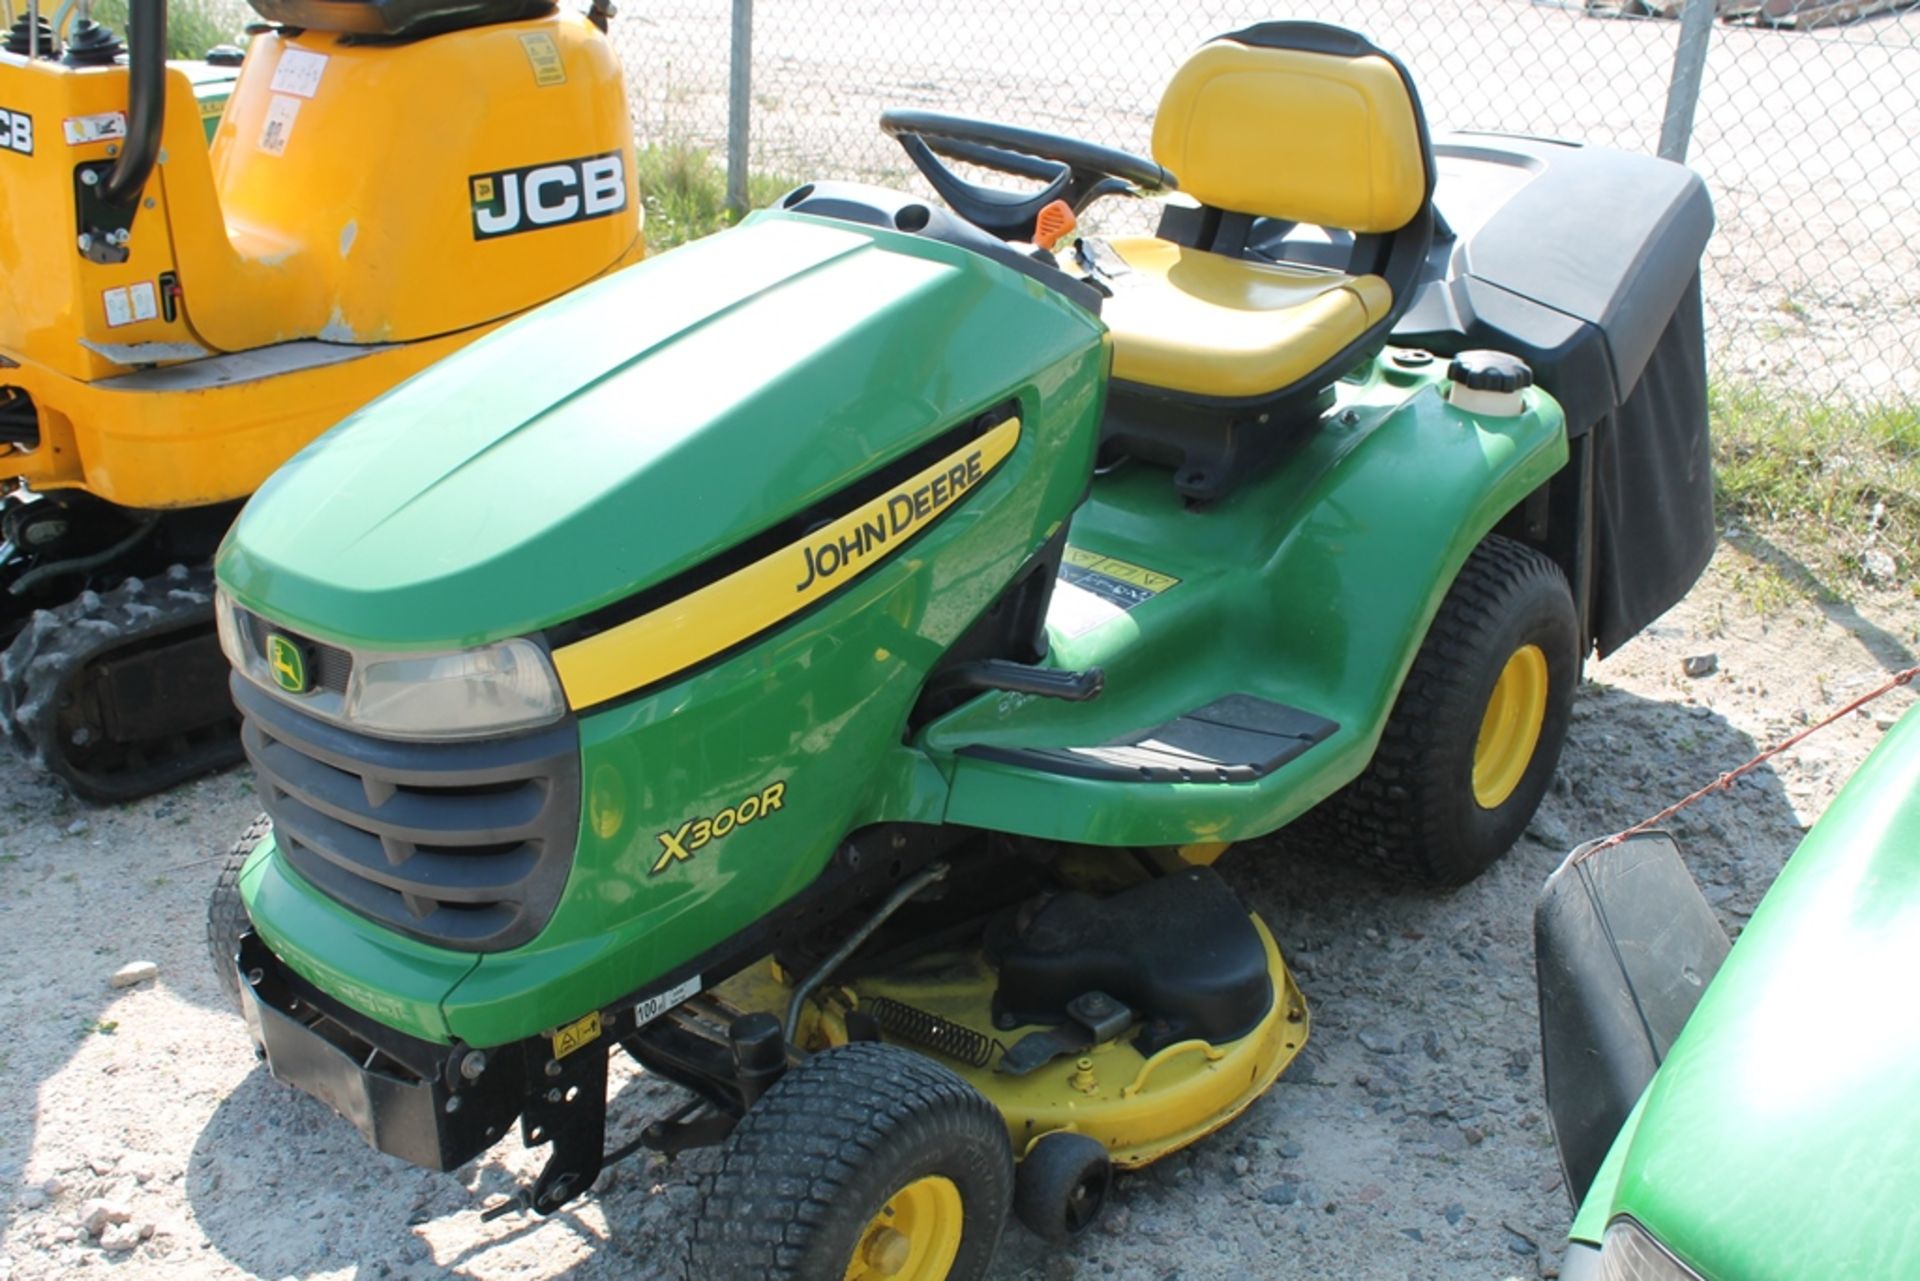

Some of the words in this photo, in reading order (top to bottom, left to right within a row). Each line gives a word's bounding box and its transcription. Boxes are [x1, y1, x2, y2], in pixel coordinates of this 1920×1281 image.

[476, 155, 625, 233] JCB
[796, 513, 886, 592] JOHN
[888, 451, 983, 536] DEERE
[649, 780, 786, 876] X300R
